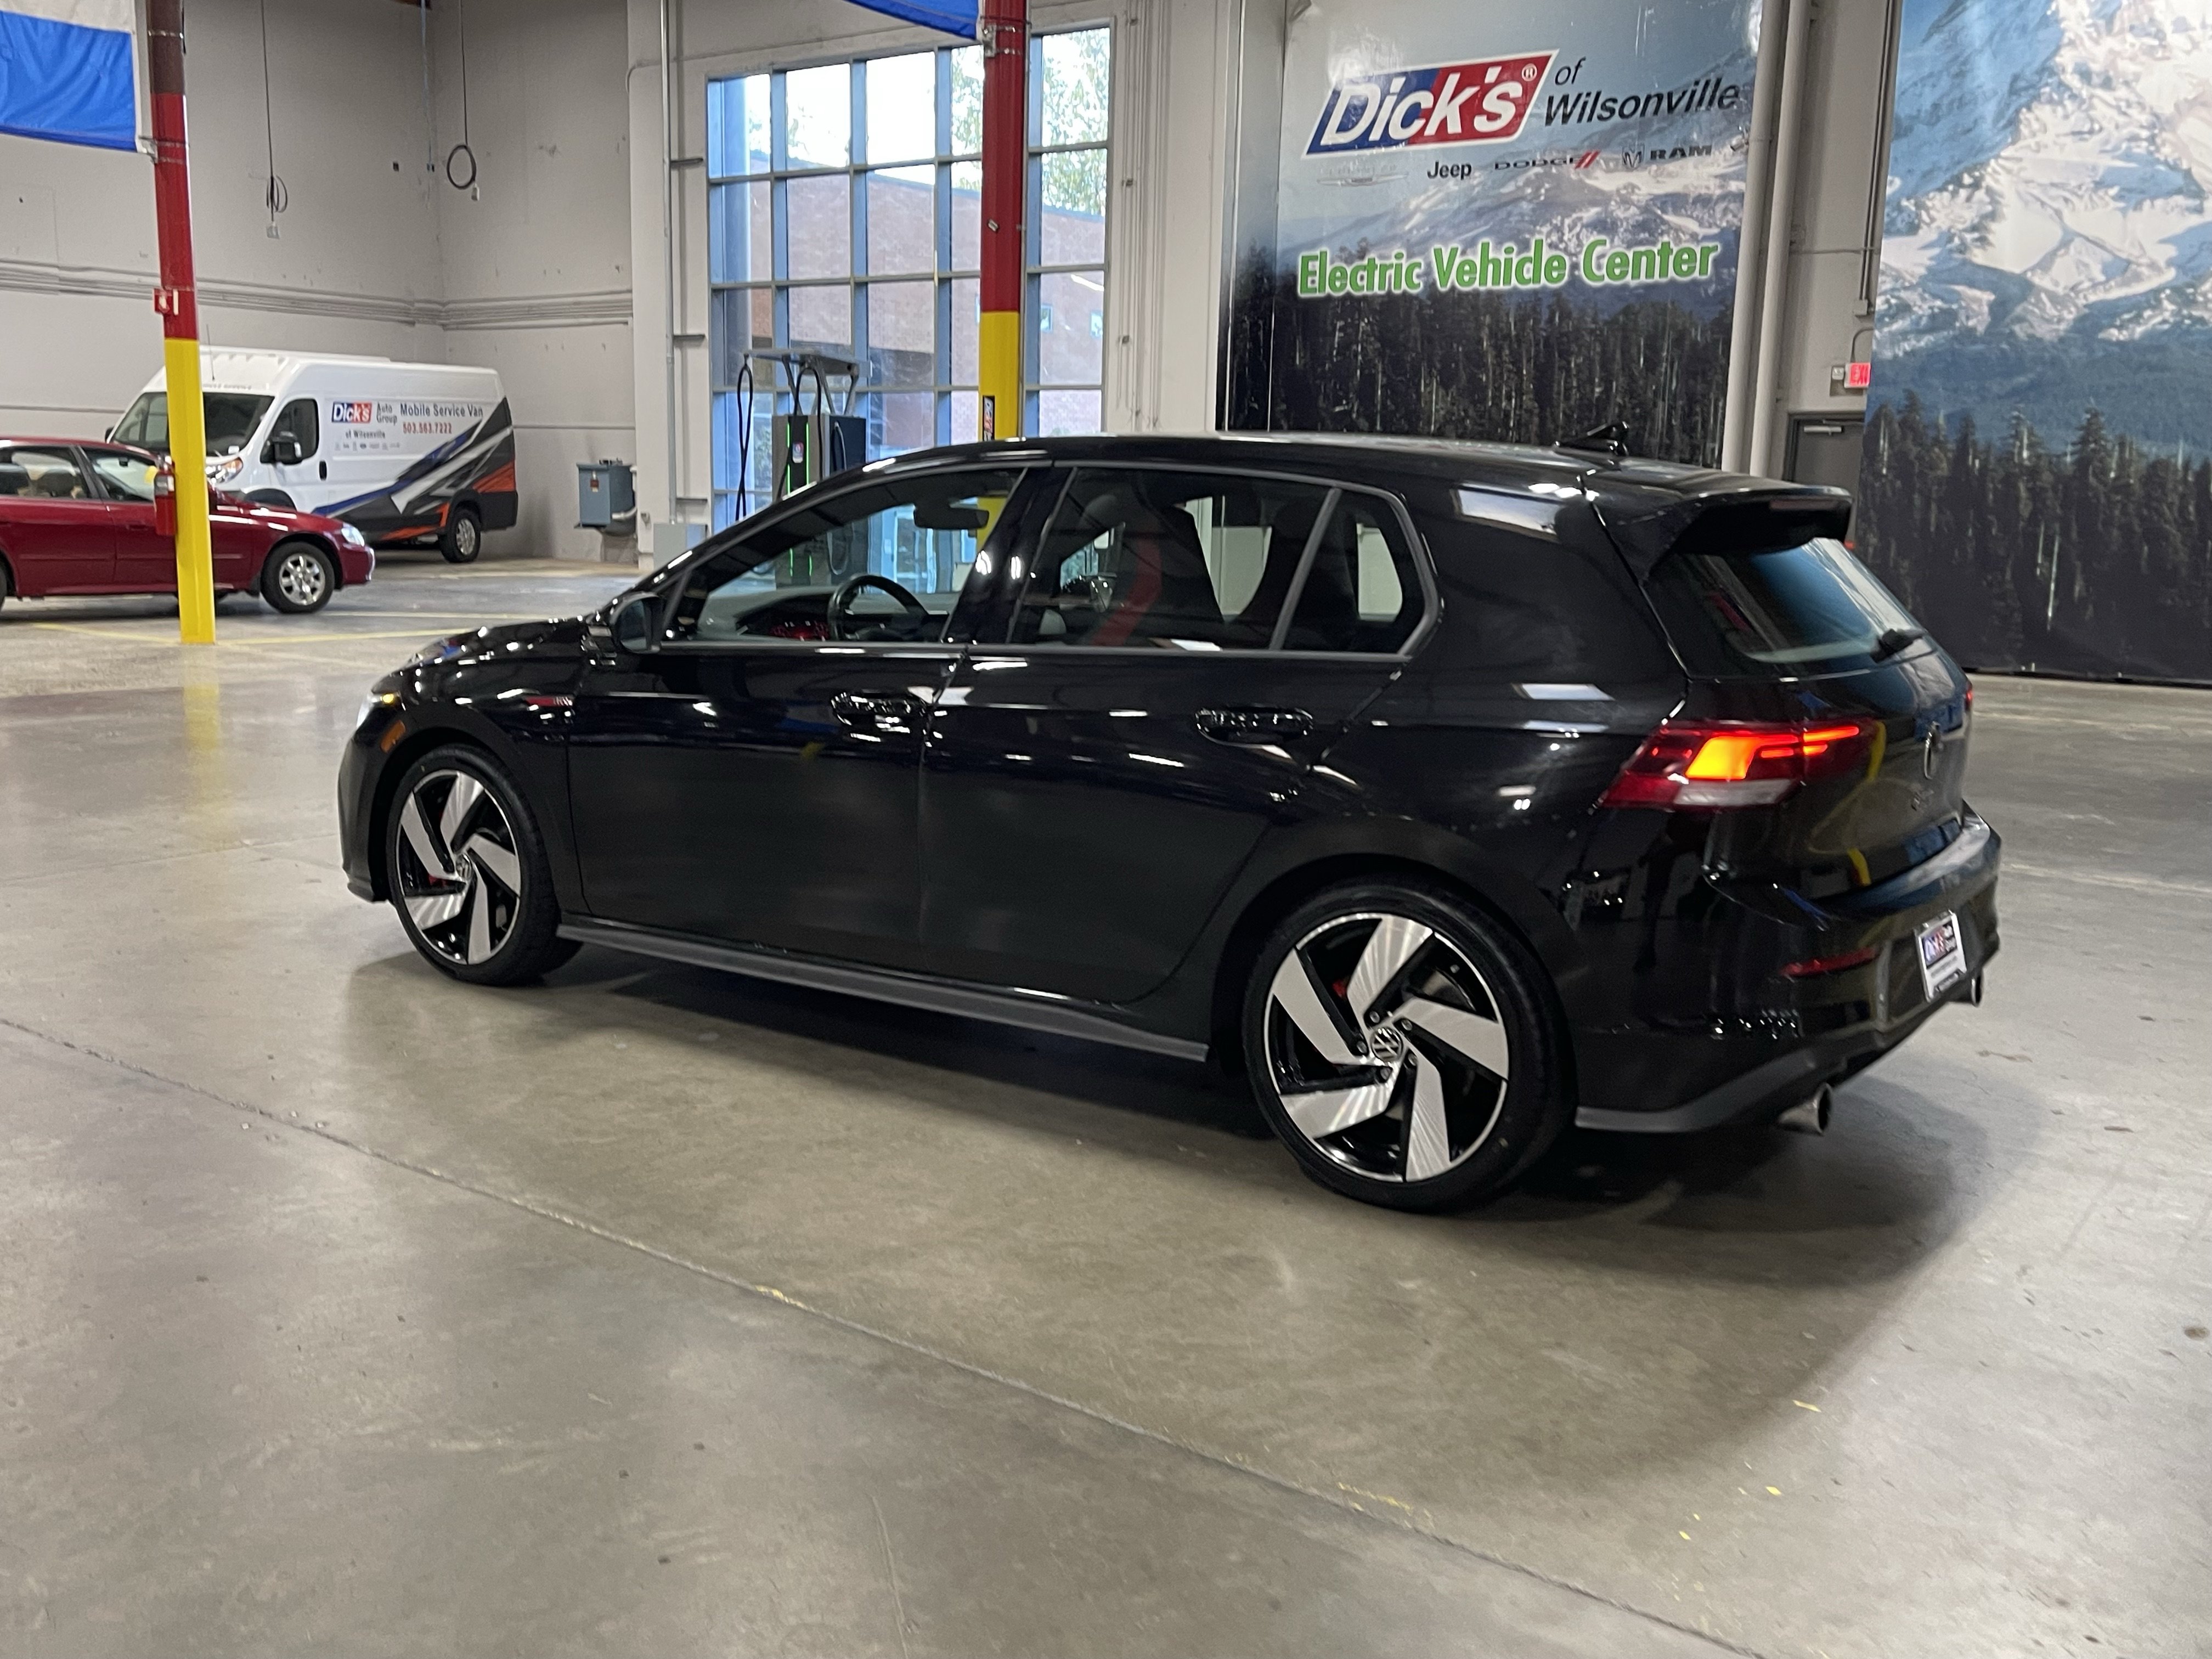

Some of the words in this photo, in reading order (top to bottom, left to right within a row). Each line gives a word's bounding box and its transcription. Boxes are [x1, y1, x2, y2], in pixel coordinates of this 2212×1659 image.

[1555, 57, 1586, 86] of
[1545, 76, 1740, 127] Wilsonville
[1650, 145, 1712, 160] RAM
[1427, 160, 1472, 180] Jeep
[1299, 252, 1424, 294] Electric
[1434, 239, 1565, 286] Vehicle
[1583, 240, 1719, 280] Center
[376, 402, 393, 414] Auto
[400, 402, 431, 417] Mobile
[433, 403, 466, 417] Service
[467, 404, 483, 417] Van
[376, 415, 398, 426] Group
